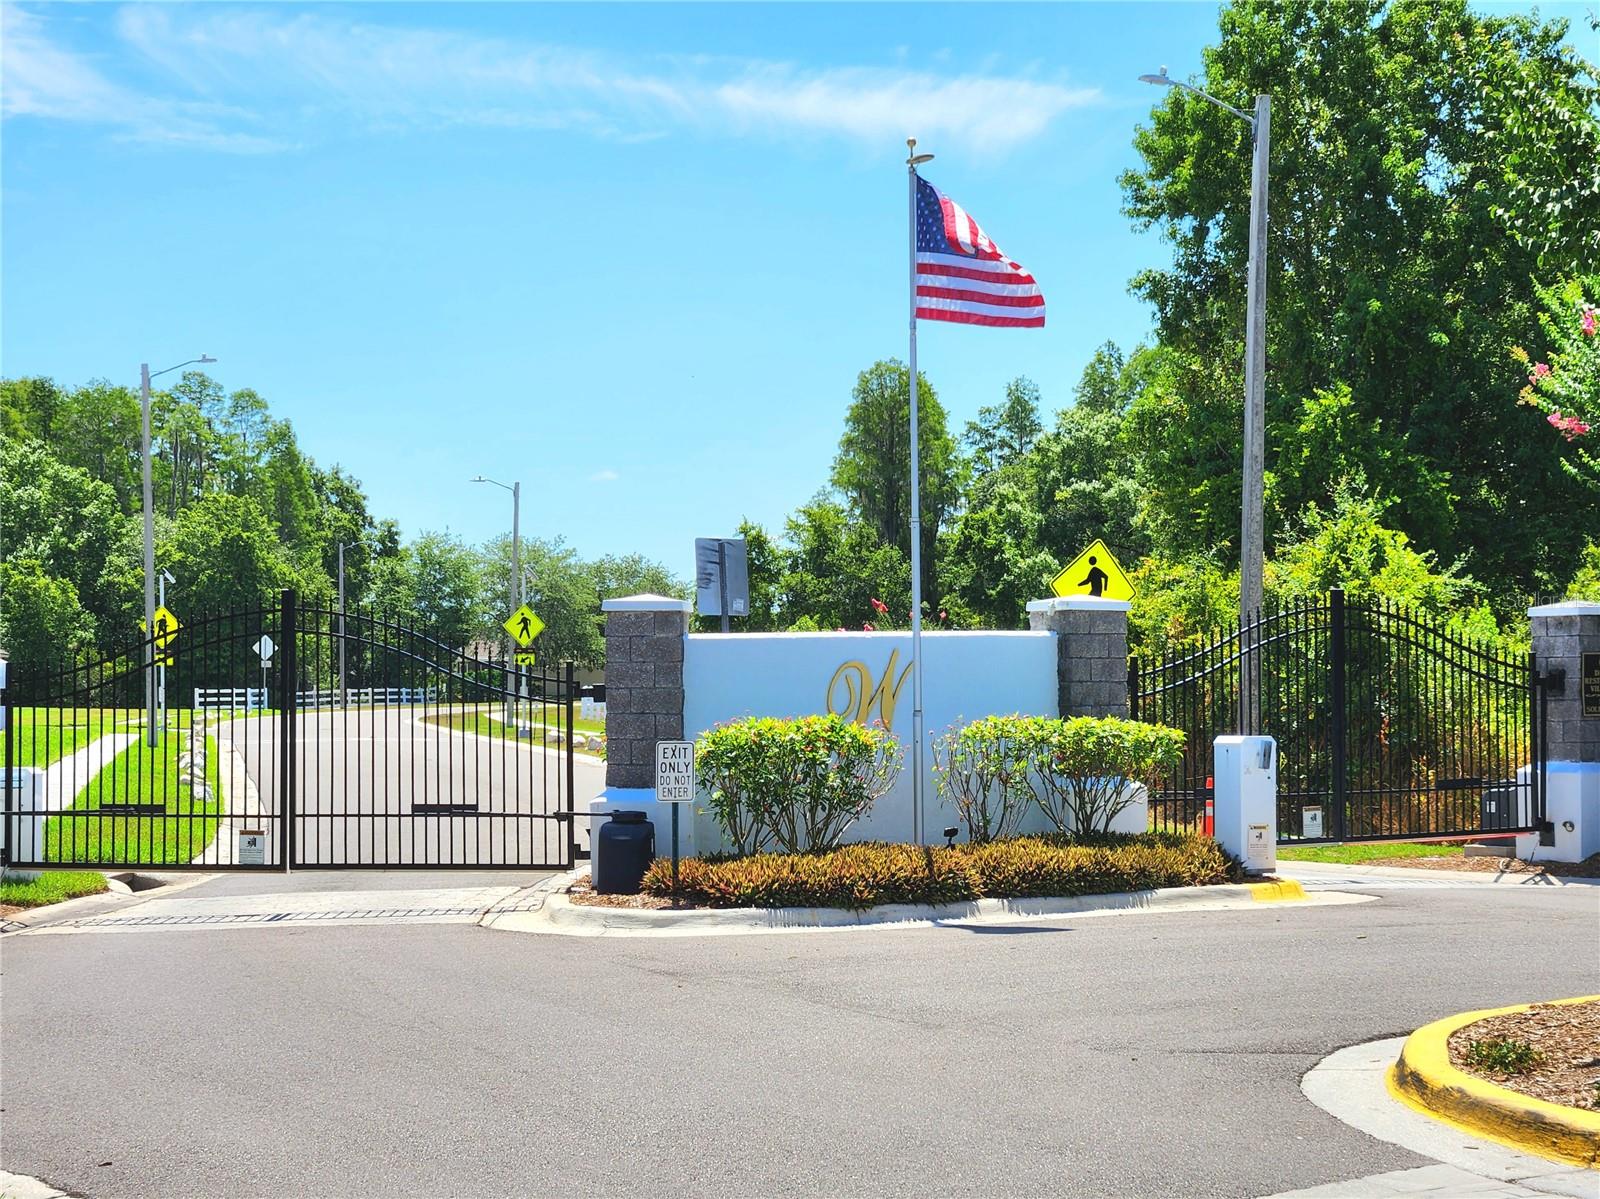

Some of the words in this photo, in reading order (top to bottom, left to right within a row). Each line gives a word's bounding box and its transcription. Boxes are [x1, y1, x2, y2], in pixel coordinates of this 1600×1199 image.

[826, 647, 914, 733] W
[662, 747, 689, 759] EXIT
[660, 761, 691, 774] ONLY
[660, 775, 671, 786] DO
[674, 775, 691, 786] NOT
[662, 786, 689, 798] ENTER
